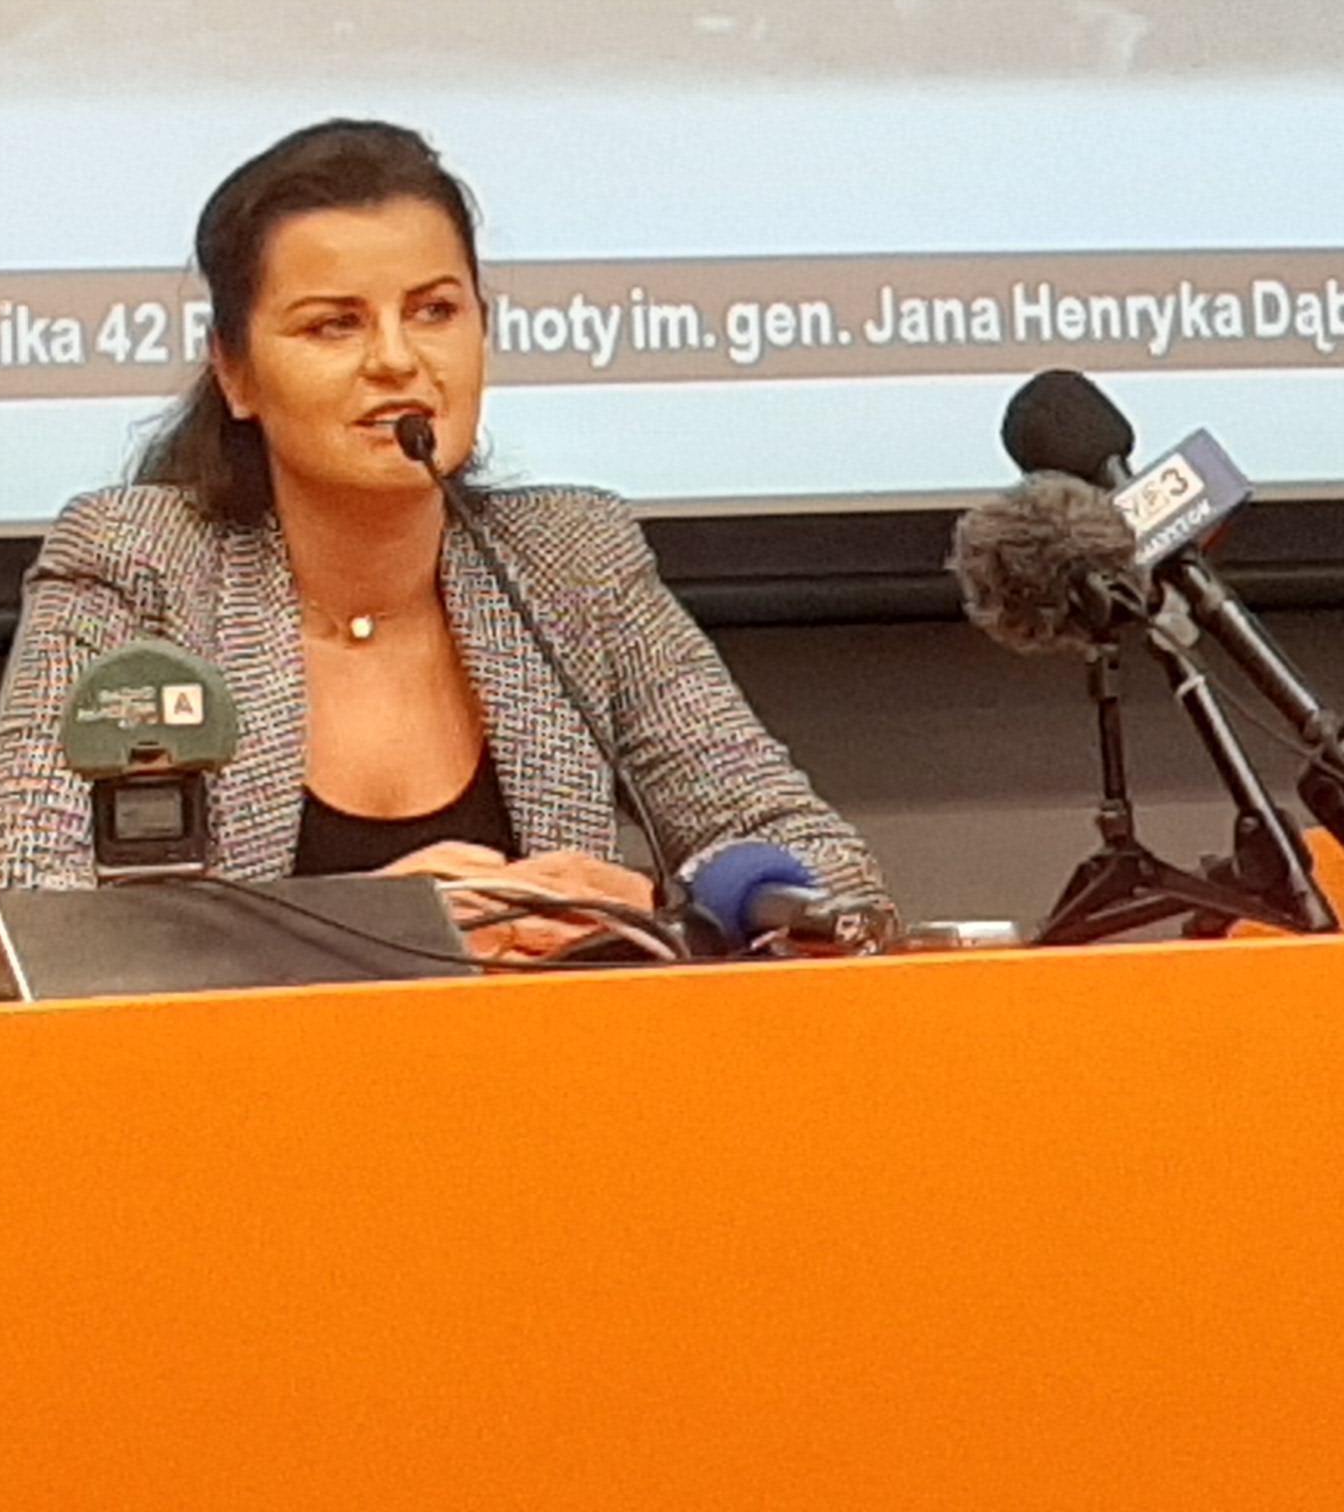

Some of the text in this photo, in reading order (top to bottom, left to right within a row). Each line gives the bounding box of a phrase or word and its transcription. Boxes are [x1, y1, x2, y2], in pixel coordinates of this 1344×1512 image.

[96, 302, 169, 364] 42
[497, 294, 621, 367] hoty
[630, 287, 716, 350] im.
[726, 301, 851, 364] gen.
[864, 286, 1002, 344] Jana
[1013, 281, 1244, 356] Henryka
